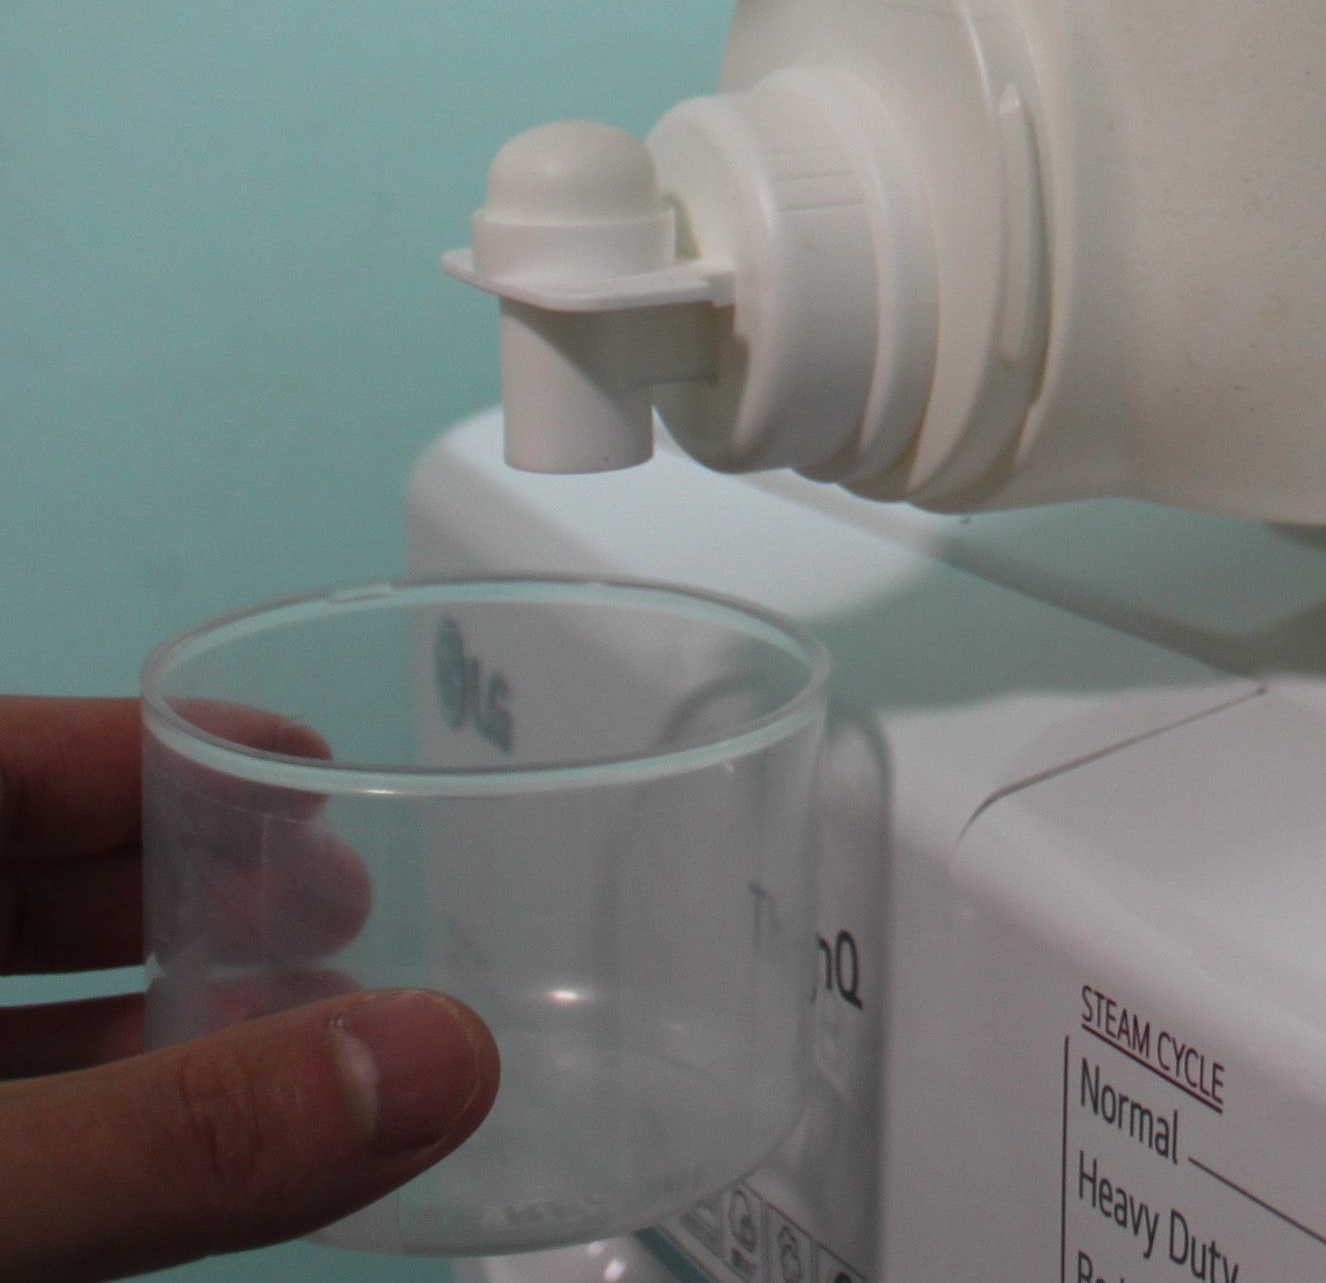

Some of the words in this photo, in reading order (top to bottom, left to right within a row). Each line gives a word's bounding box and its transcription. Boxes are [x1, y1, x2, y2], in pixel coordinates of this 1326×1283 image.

[1080, 984, 1151, 1060] STEAM
[1157, 1030, 1225, 1105] CYCLE
[1080, 1057, 1179, 1165] Normal
[1078, 1149, 1160, 1260] Heavy
